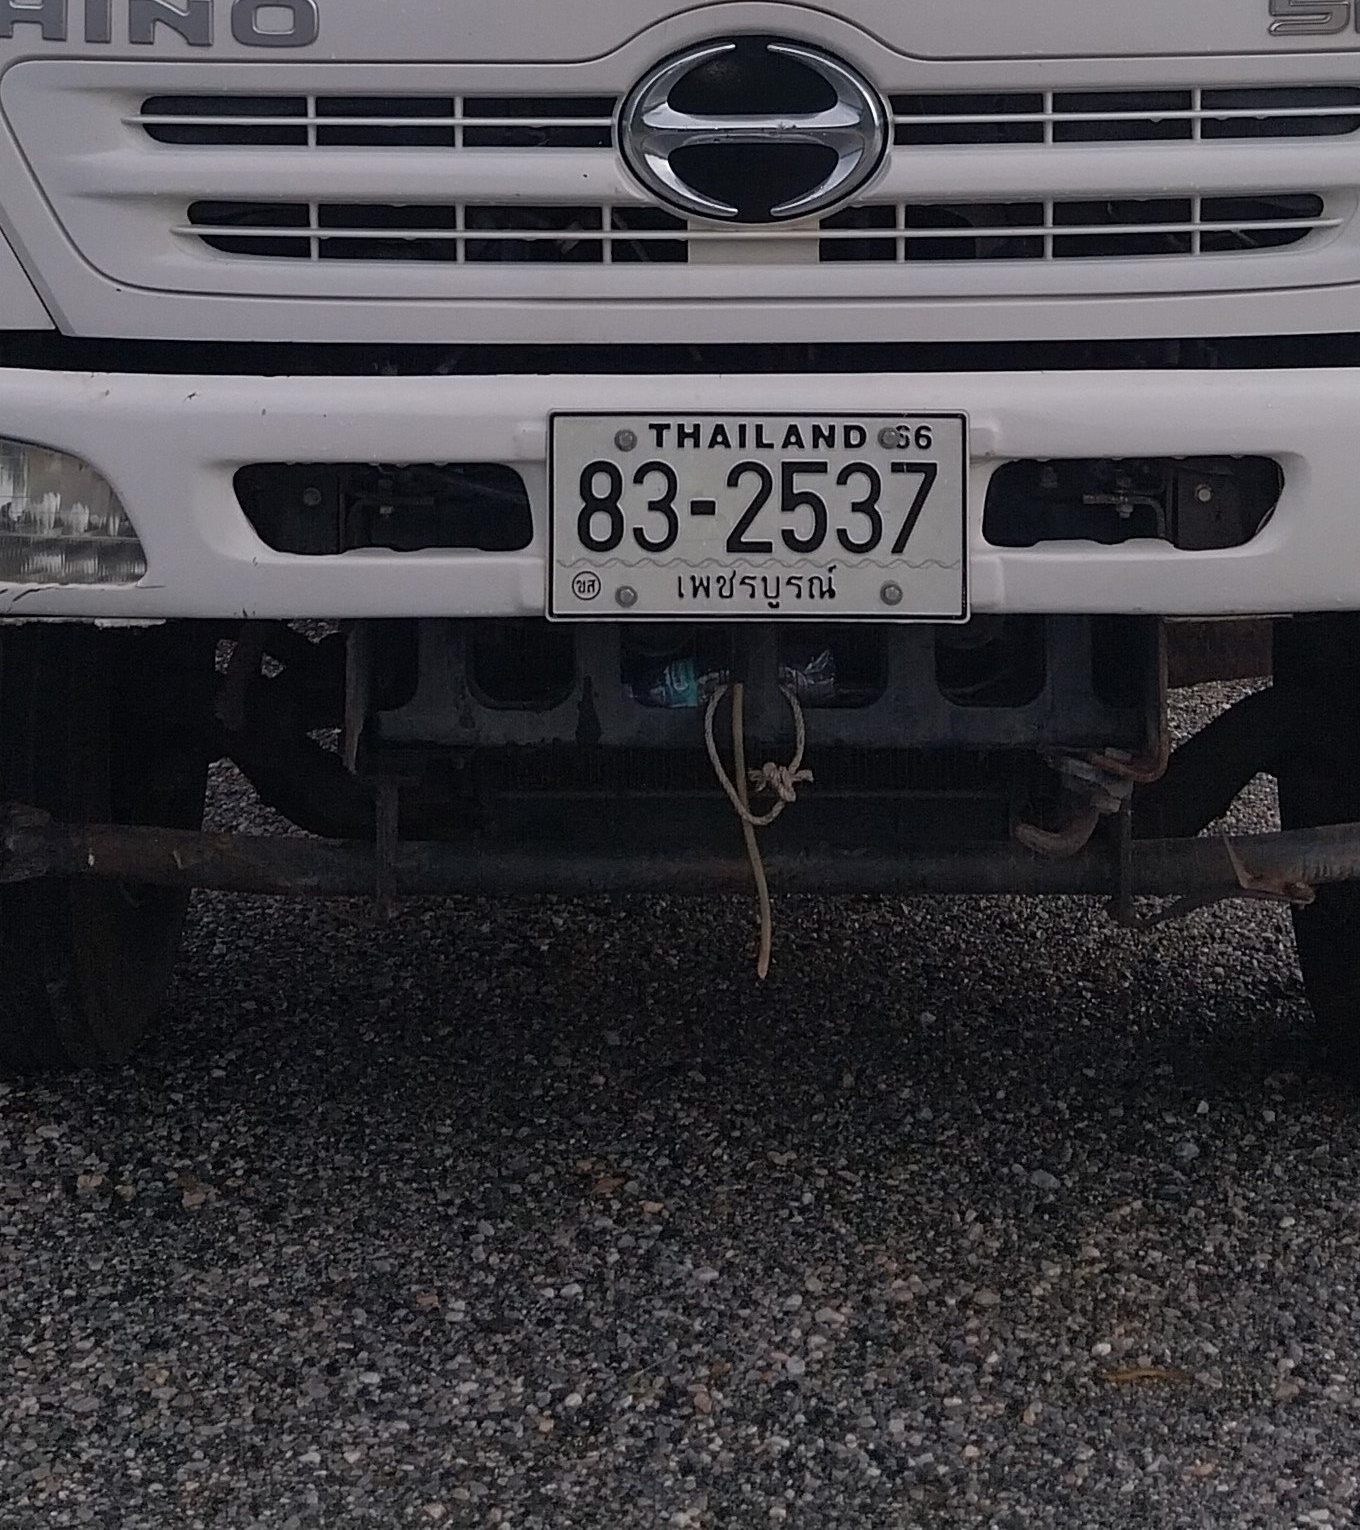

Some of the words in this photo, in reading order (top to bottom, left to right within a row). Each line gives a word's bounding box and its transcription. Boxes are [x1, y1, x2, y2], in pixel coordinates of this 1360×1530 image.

[647, 423, 868, 450] THAILAND
[576, 460, 939, 556] 83-2537
[677, 564, 838, 610] เพชรบูรณ์
